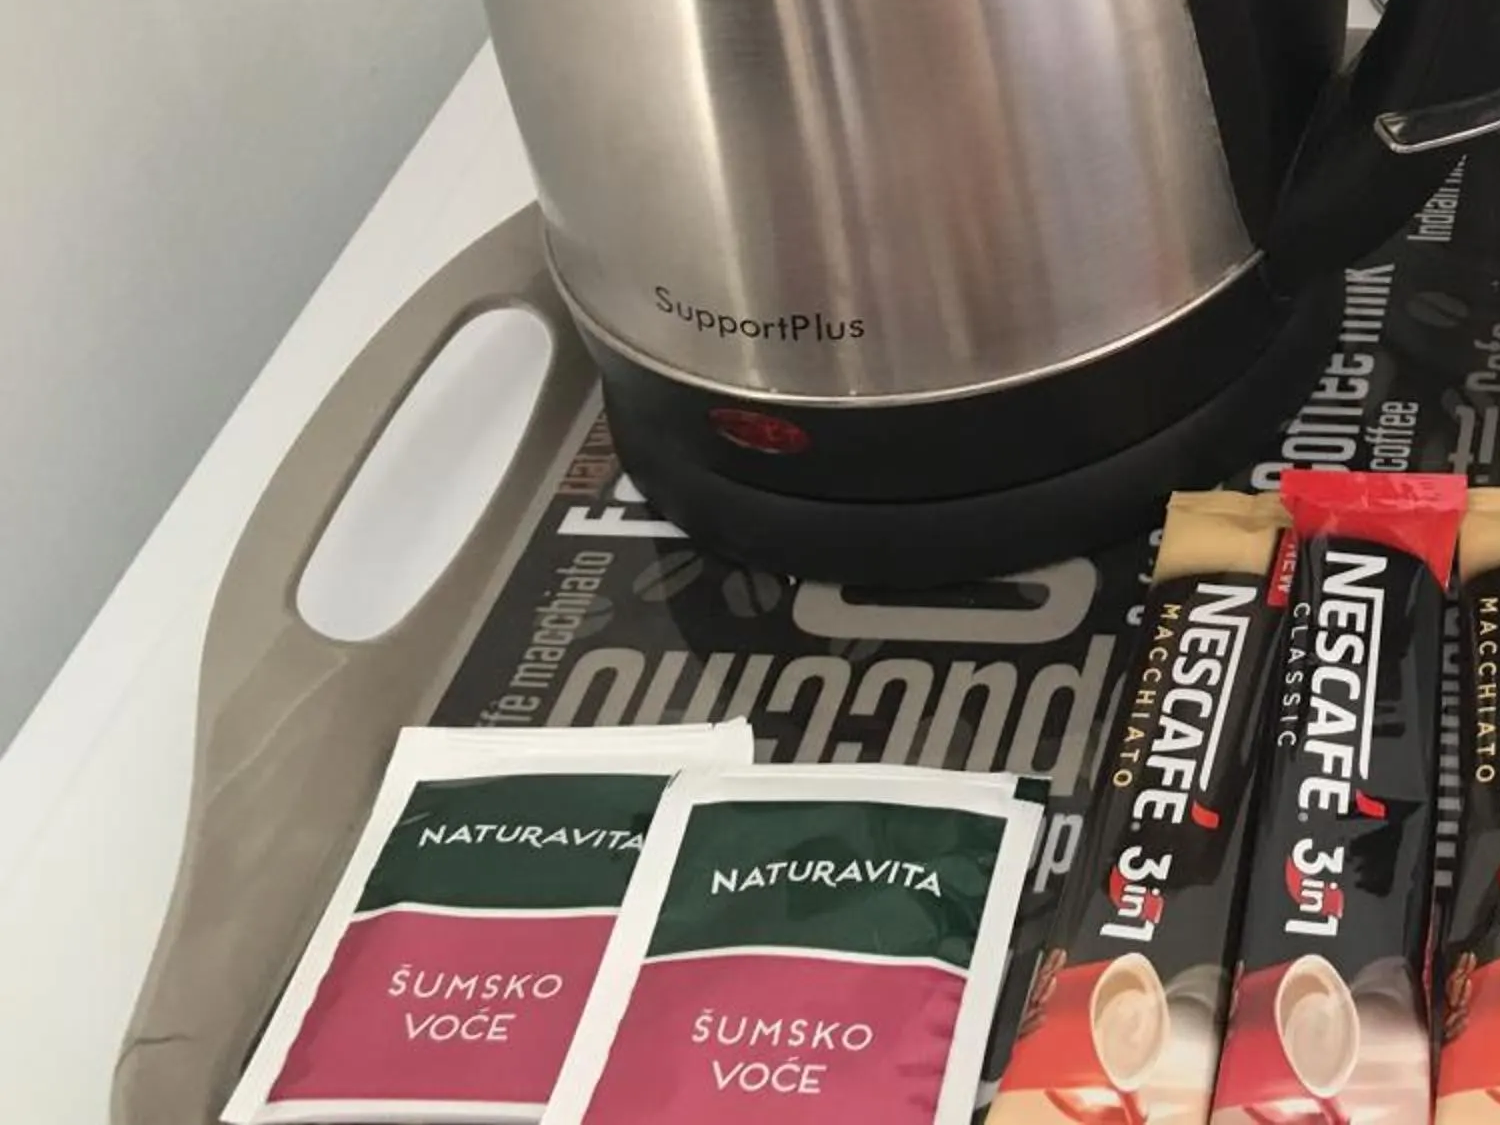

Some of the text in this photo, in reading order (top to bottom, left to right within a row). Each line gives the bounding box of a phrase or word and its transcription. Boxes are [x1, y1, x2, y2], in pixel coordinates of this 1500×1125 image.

[655, 285, 865, 342] SupportPlus
[510, 551, 614, 688] macchiato
[1112, 603, 1182, 787] MACCHIATO
[1277, 601, 1311, 747] CLASSIC
[1475, 596, 1498, 783] MACCHIATO
[418, 824, 644, 851] NATURAVITA
[711, 859, 942, 898] NATURAVITA
[388, 963, 563, 1001] ŠUMSKO
[404, 1006, 517, 1043] VOĆE
[691, 1007, 874, 1051] ŠUMSKO
[712, 1056, 828, 1095] VOĆE
